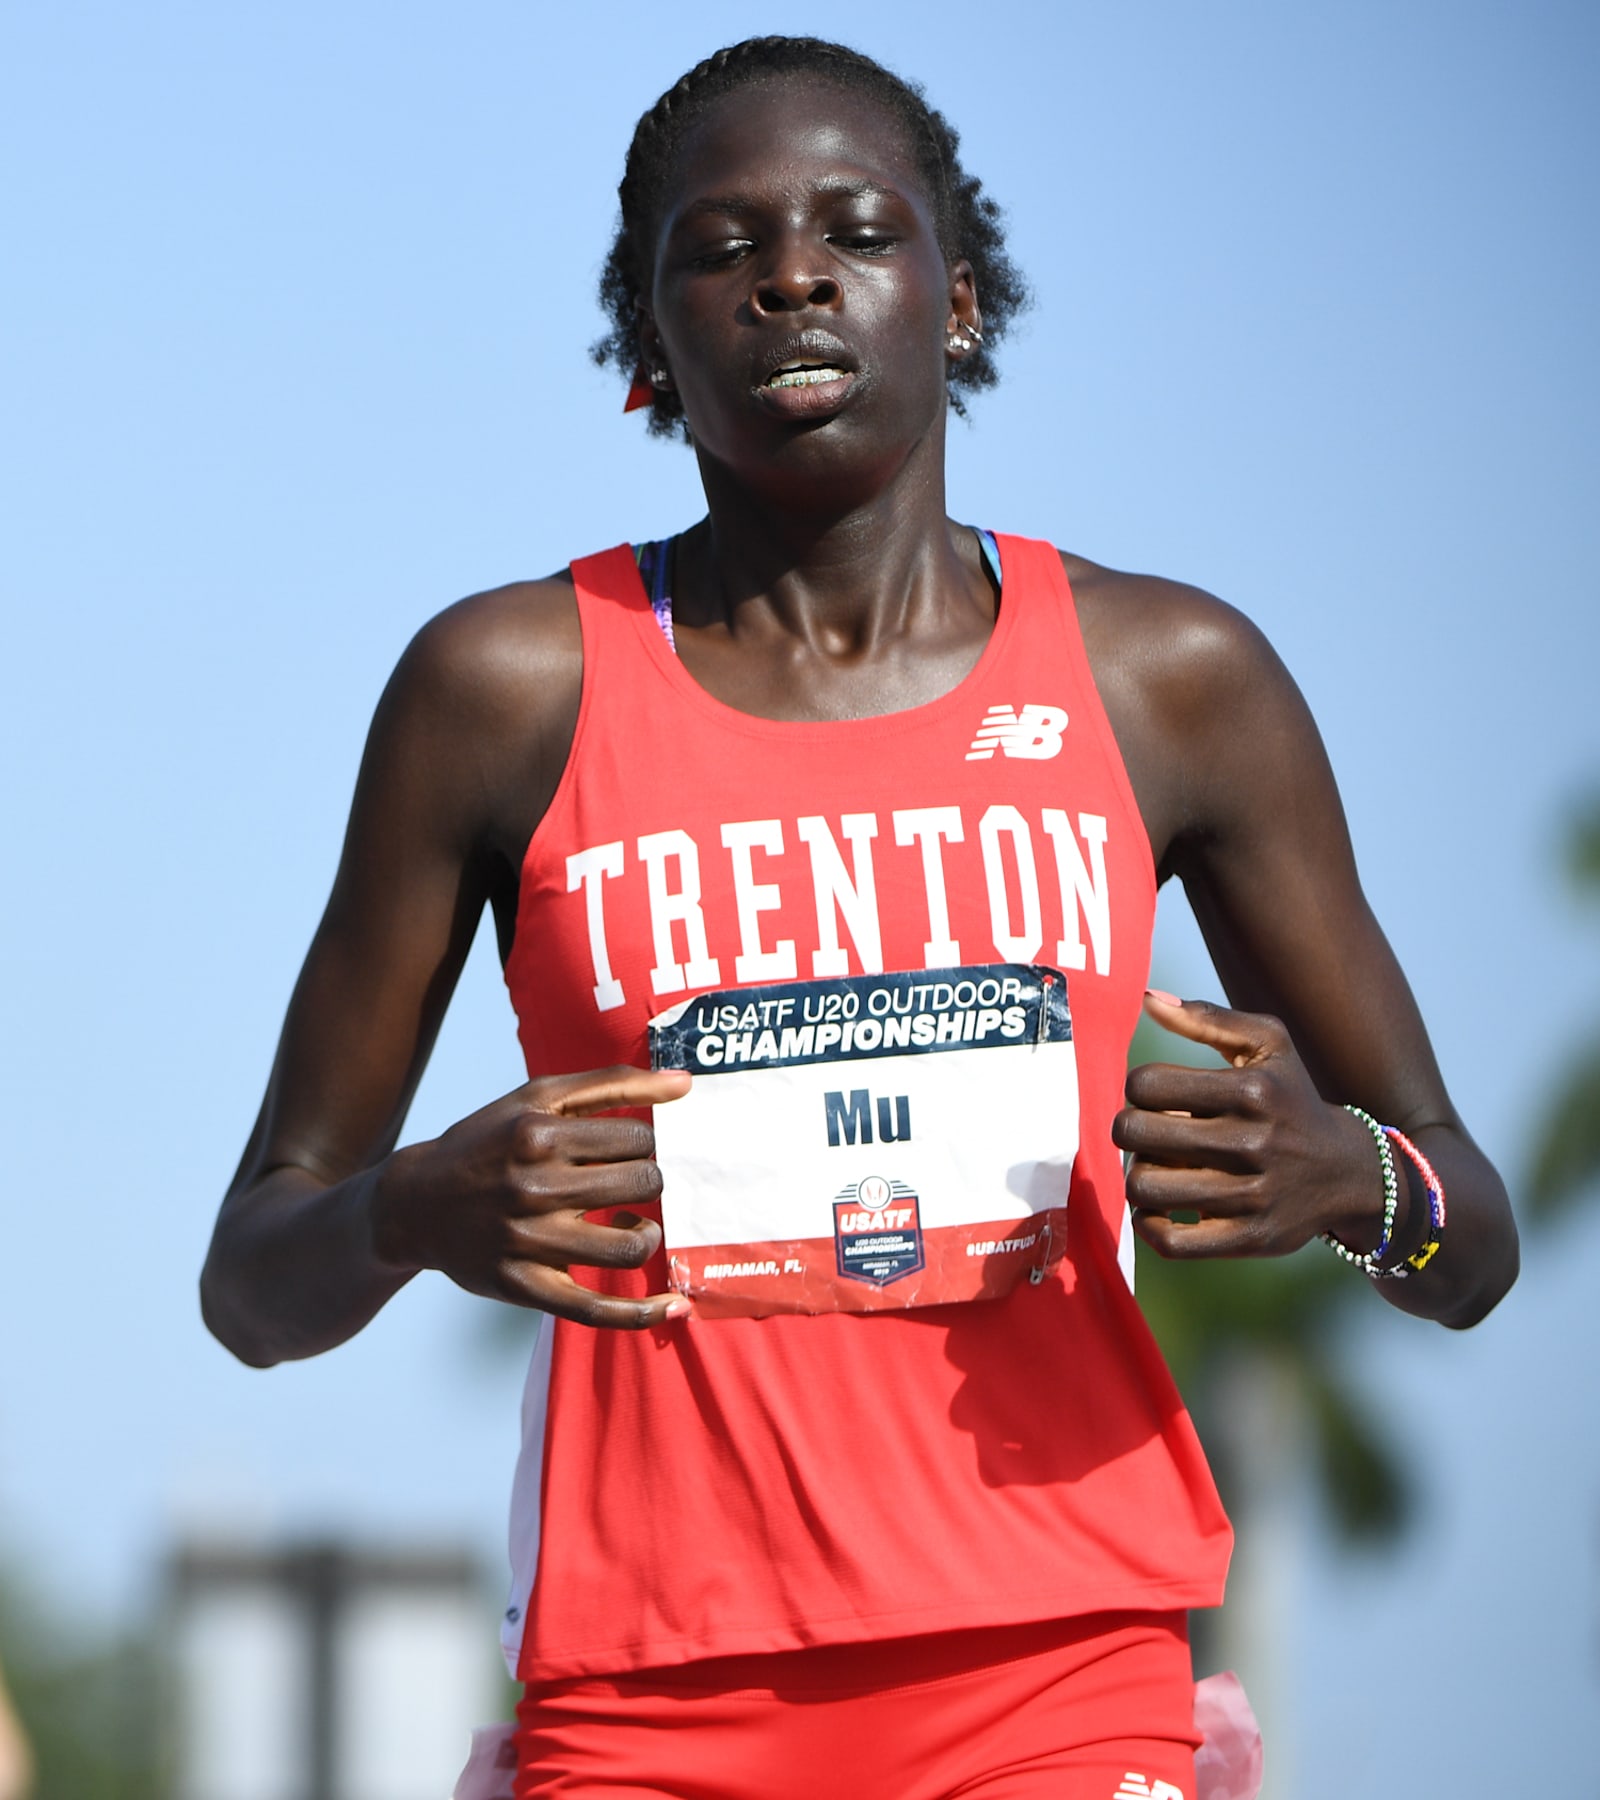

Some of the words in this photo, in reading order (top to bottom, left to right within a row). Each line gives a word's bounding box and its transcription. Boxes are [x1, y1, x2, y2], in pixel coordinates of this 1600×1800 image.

[965, 704, 1069, 760] NB
[565, 805, 1111, 1012] TRENTON
[696, 998, 795, 1034] USATF
[803, 992, 859, 1022] U20
[867, 978, 1023, 1017] OUTDOOR
[695, 1006, 1027, 1067] CHAMPIONSHIPS
[823, 1088, 912, 1147] Mu
[840, 1208, 913, 1233] USATF
[703, 1261, 780, 1279] MIRAMAR,
[784, 1259, 803, 1274] FL
